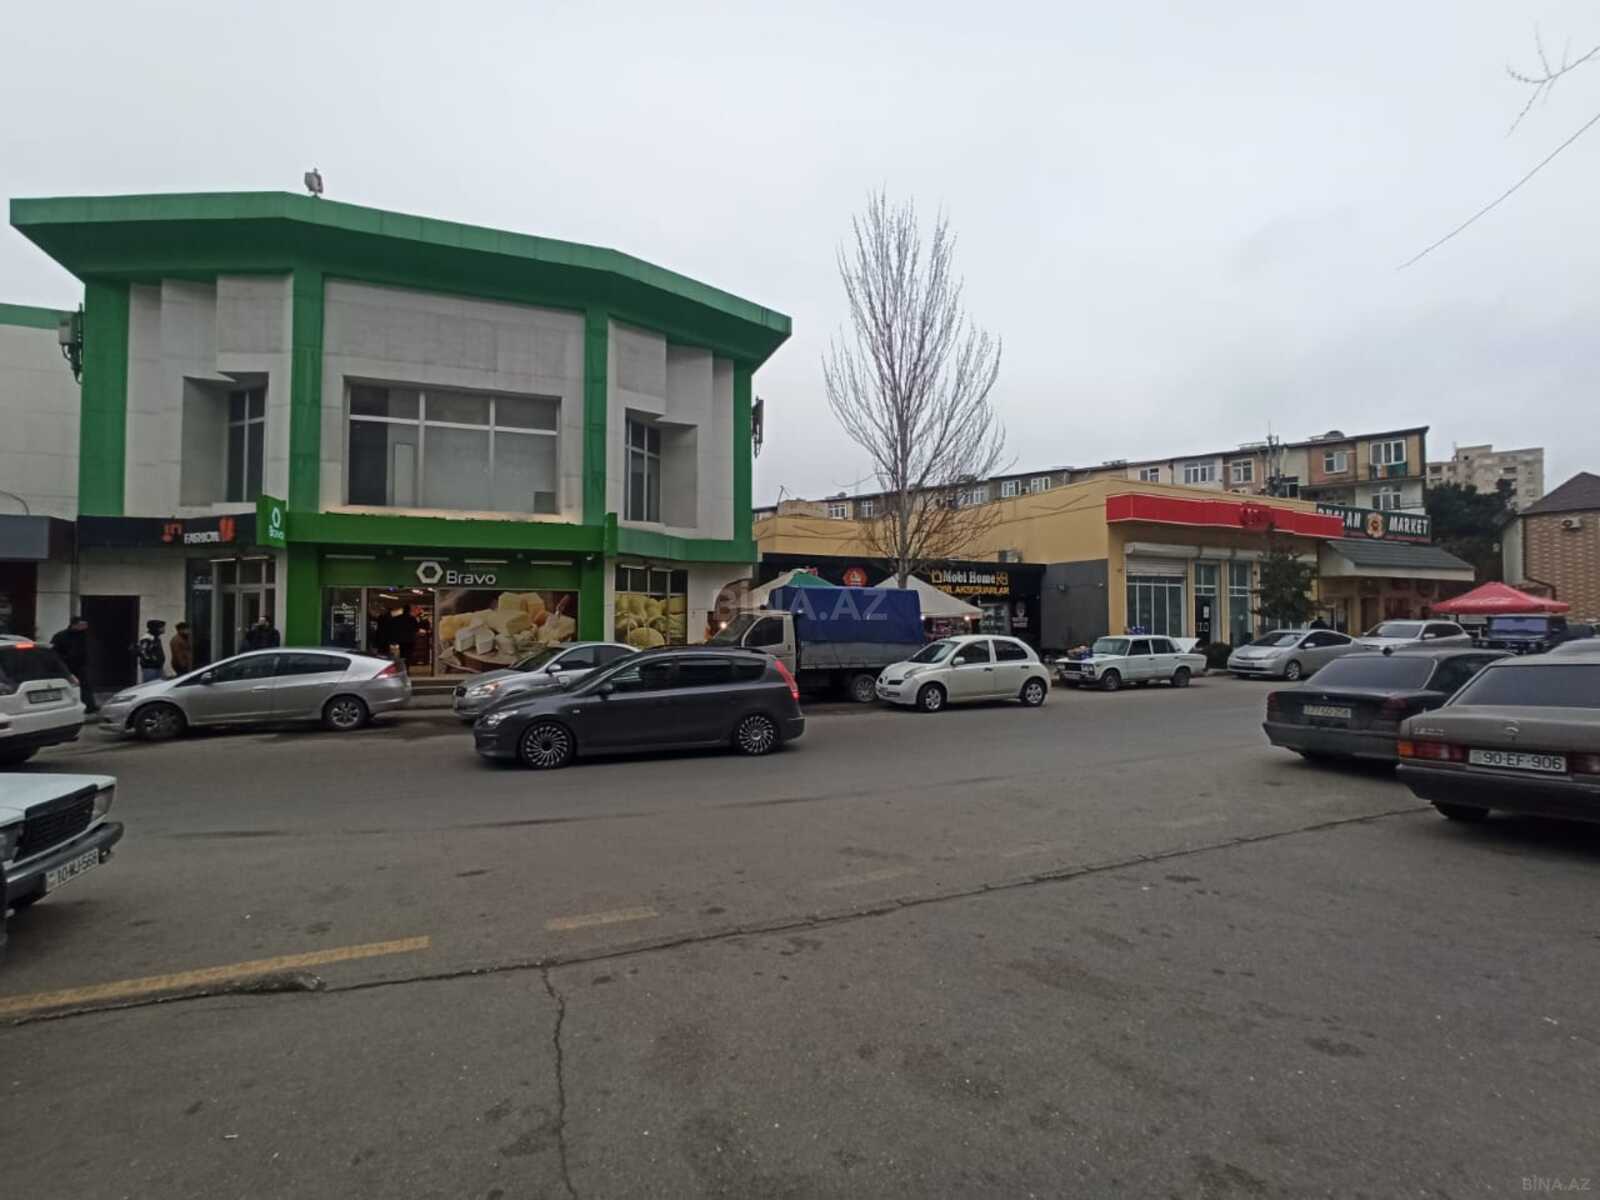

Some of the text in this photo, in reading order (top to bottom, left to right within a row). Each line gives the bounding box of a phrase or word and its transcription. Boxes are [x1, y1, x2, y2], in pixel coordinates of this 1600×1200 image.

[1388, 516, 1428, 533] MARKET
[446, 570, 497, 584] Bravo
[969, 571, 996, 584] Home
[1483, 752, 1562, 769] 90-EF-906
